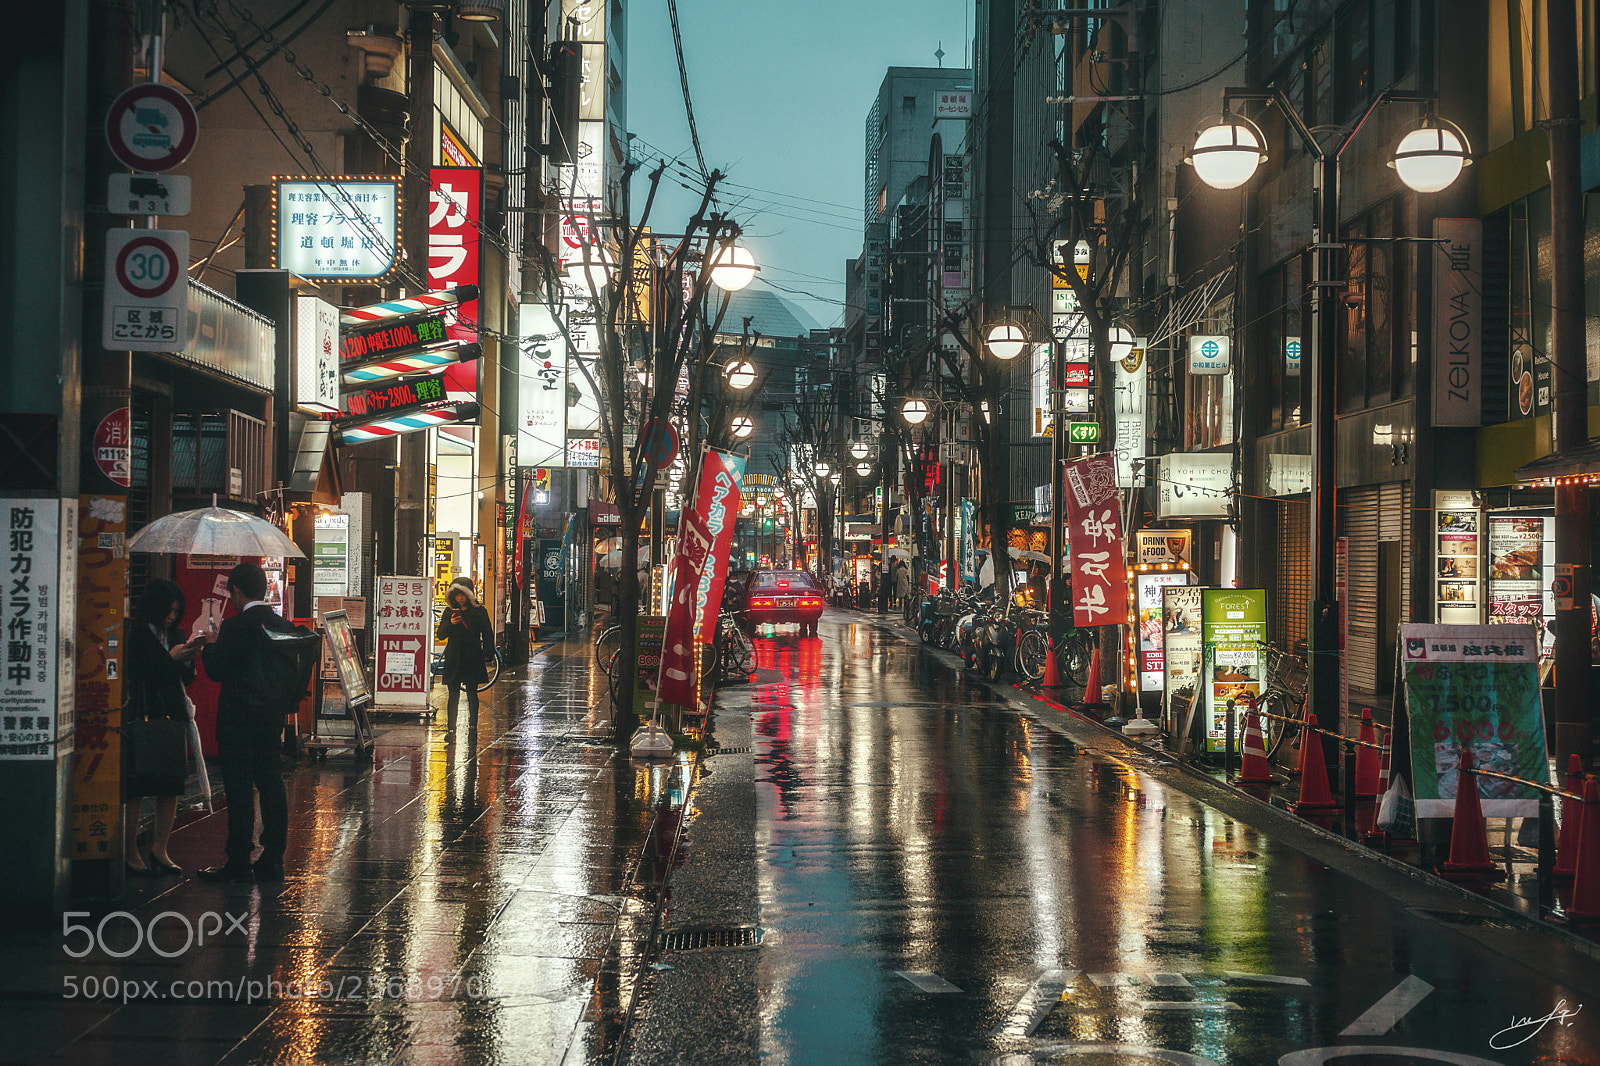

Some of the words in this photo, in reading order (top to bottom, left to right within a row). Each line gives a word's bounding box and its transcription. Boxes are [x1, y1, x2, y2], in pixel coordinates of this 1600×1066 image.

[291, 212, 318, 226] 理容
[300, 236, 376, 249] 道頓堀店
[130, 253, 165, 280] 30
[128, 310, 163, 323] 区域
[115, 324, 175, 339] ここから
[416, 320, 444, 342] 理容
[347, 395, 366, 416] 900
[415, 378, 442, 400] 理容
[1072, 424, 1097, 438] くすり
[1118, 421, 1129, 461] PRIMO
[1142, 537, 1166, 546] DRINK
[1142, 547, 1166, 556] &FOOD
[382, 582, 423, 596] 설렁탕
[8, 507, 33, 686] 防犯カメラ作動中
[381, 606, 424, 618] 雪濃湯
[1220, 600, 1249, 610] FOREST
[1493, 604, 1541, 615] スタッフ
[383, 623, 420, 635] スープ専門店
[383, 640, 400, 650] IN
[381, 674, 421, 689] OPEN
